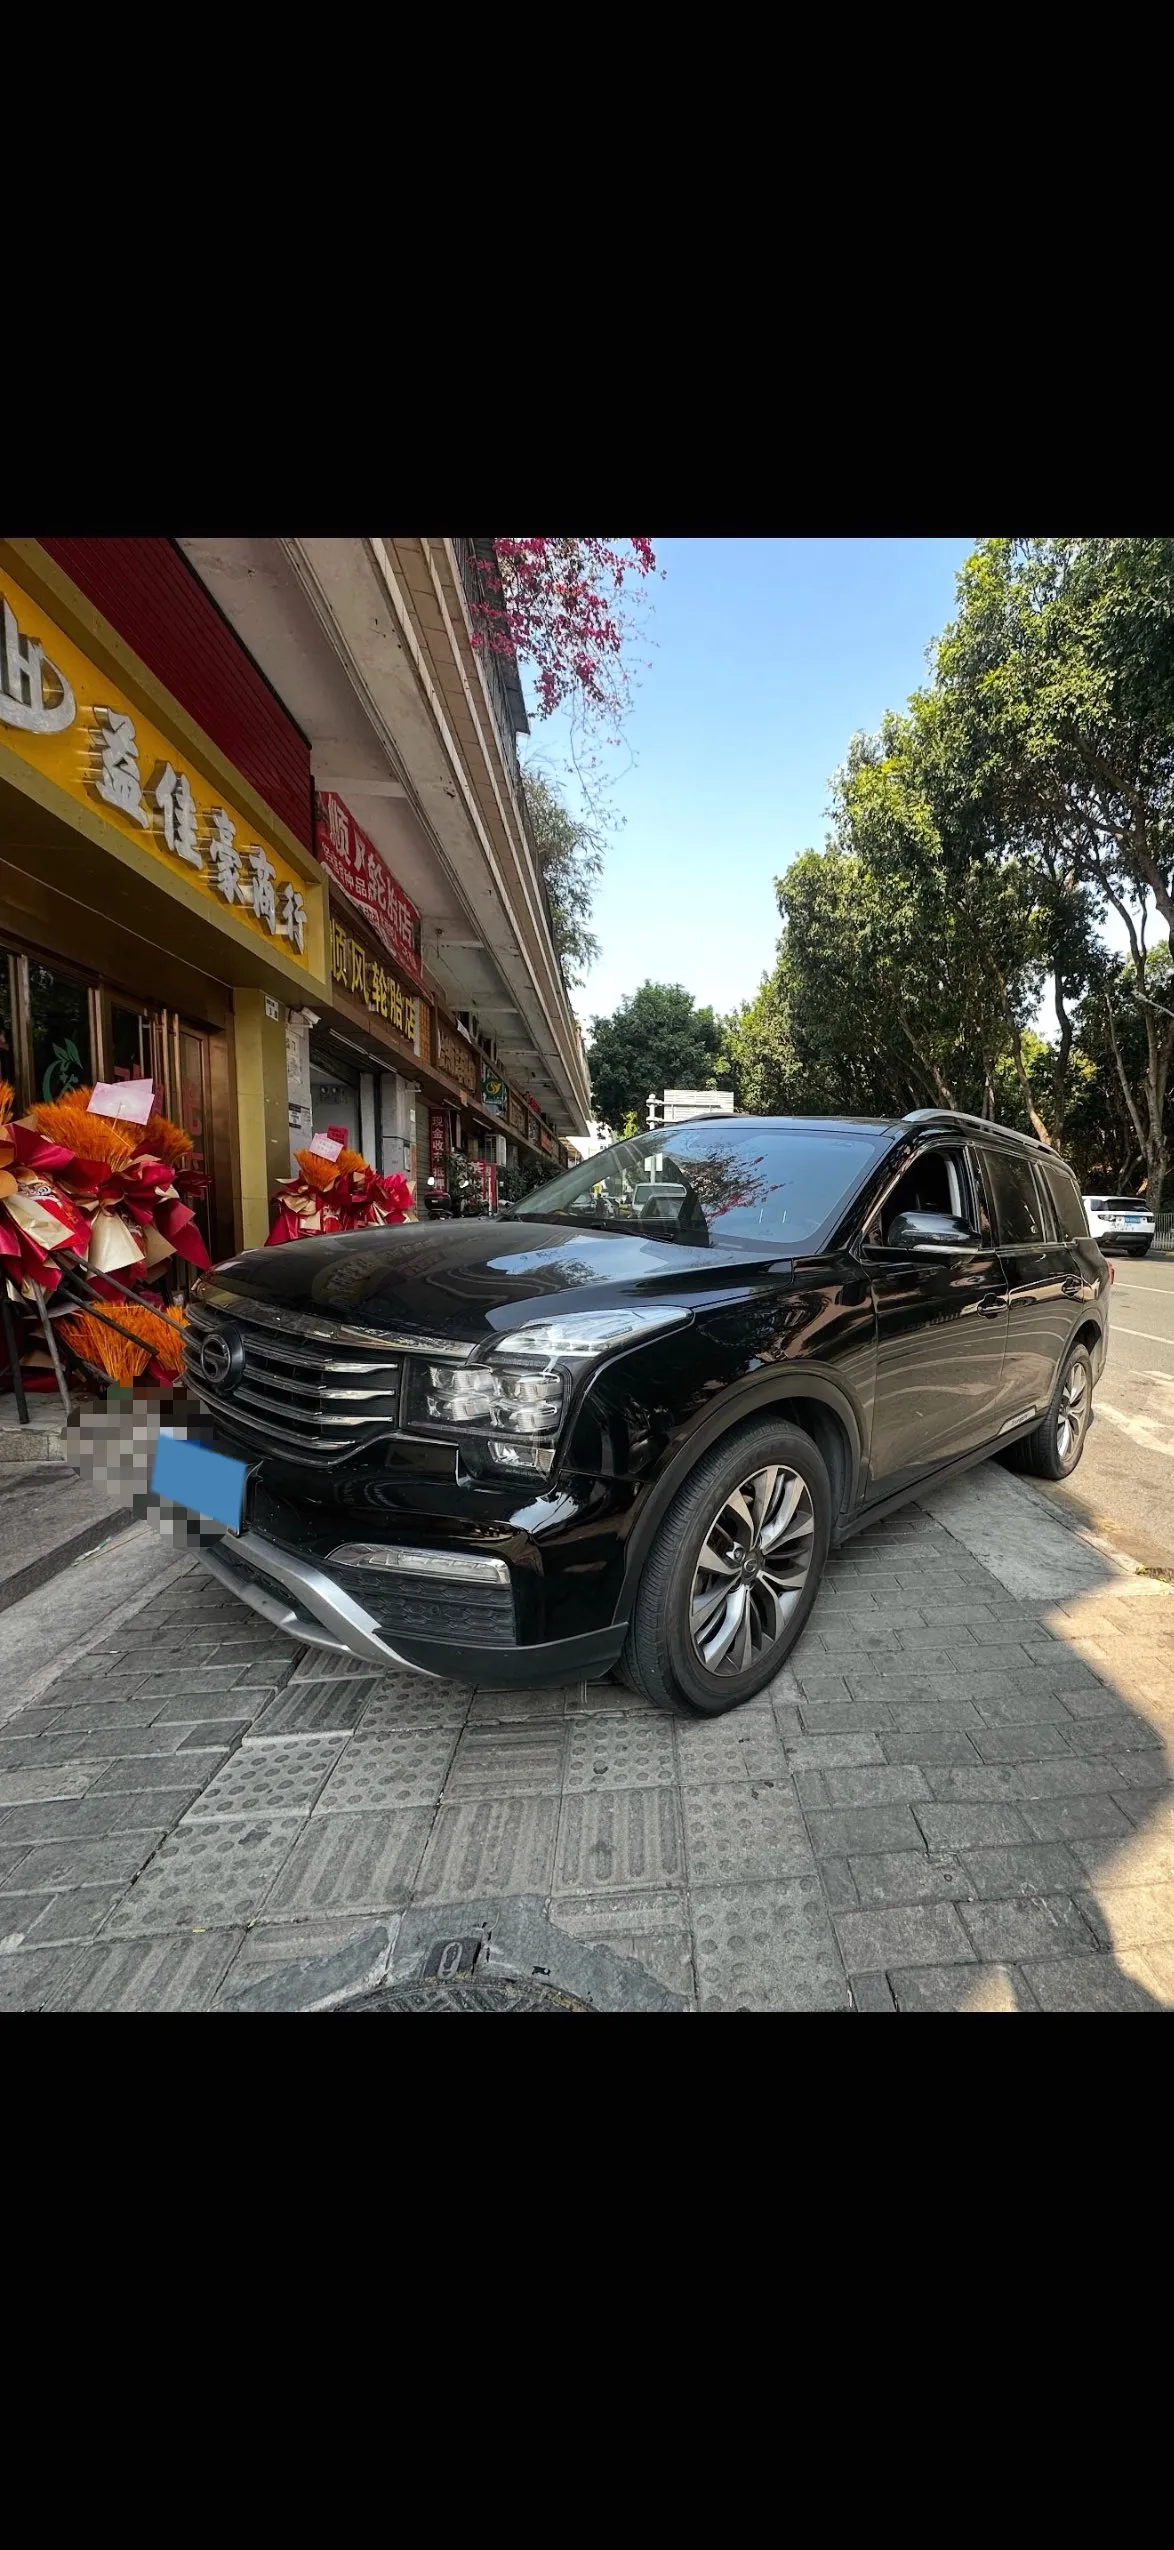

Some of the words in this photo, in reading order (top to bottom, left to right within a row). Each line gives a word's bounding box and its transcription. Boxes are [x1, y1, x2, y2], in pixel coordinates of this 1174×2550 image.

[93, 706, 307, 956] 益佳豪商行
